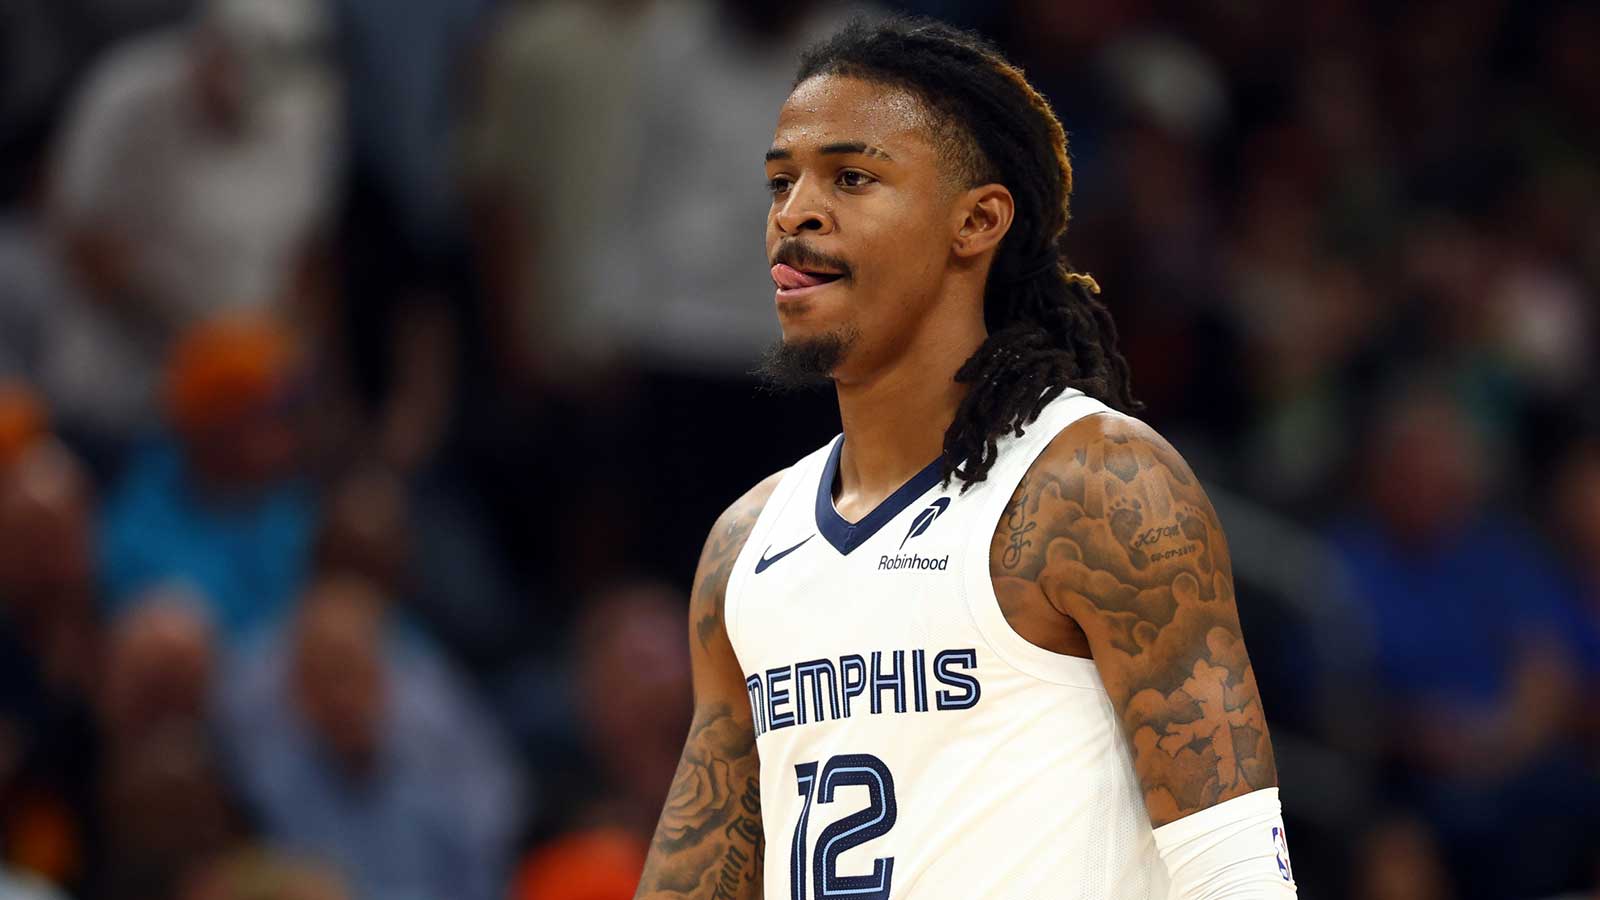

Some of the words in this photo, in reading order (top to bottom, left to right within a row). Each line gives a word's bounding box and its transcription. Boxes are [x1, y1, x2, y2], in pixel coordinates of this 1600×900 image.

[877, 553, 949, 571] Robinhood
[747, 648, 982, 739] MEMPHIS
[790, 753, 898, 900] 12
